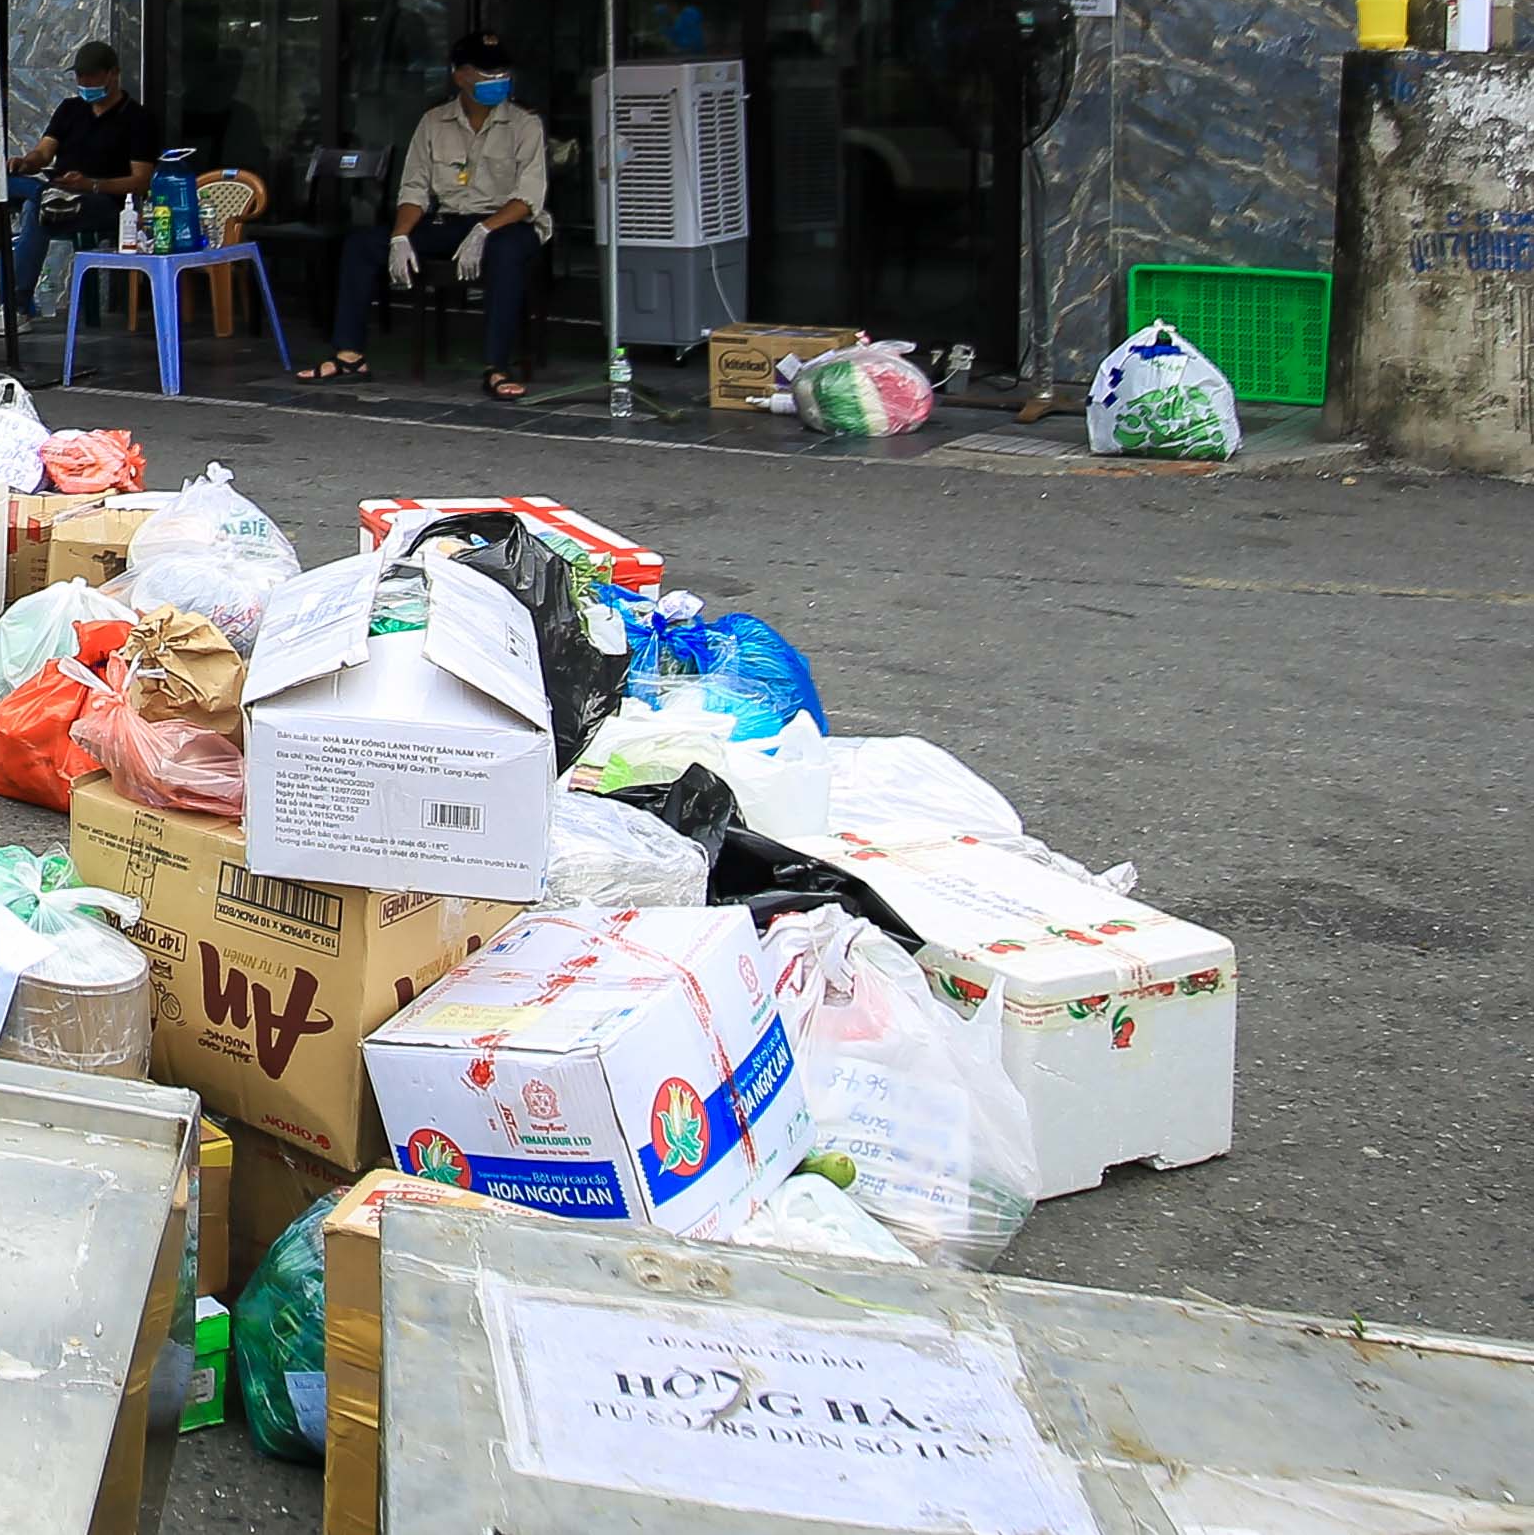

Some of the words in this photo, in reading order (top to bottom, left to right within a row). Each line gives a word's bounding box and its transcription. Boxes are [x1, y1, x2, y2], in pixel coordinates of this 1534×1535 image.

[198, 940, 334, 1080] An
[569, 1174, 588, 1184] cao
[487, 1182, 524, 1202] HOA
[524, 1184, 576, 1207] NGỌC
[577, 1187, 614, 1206] LAN
